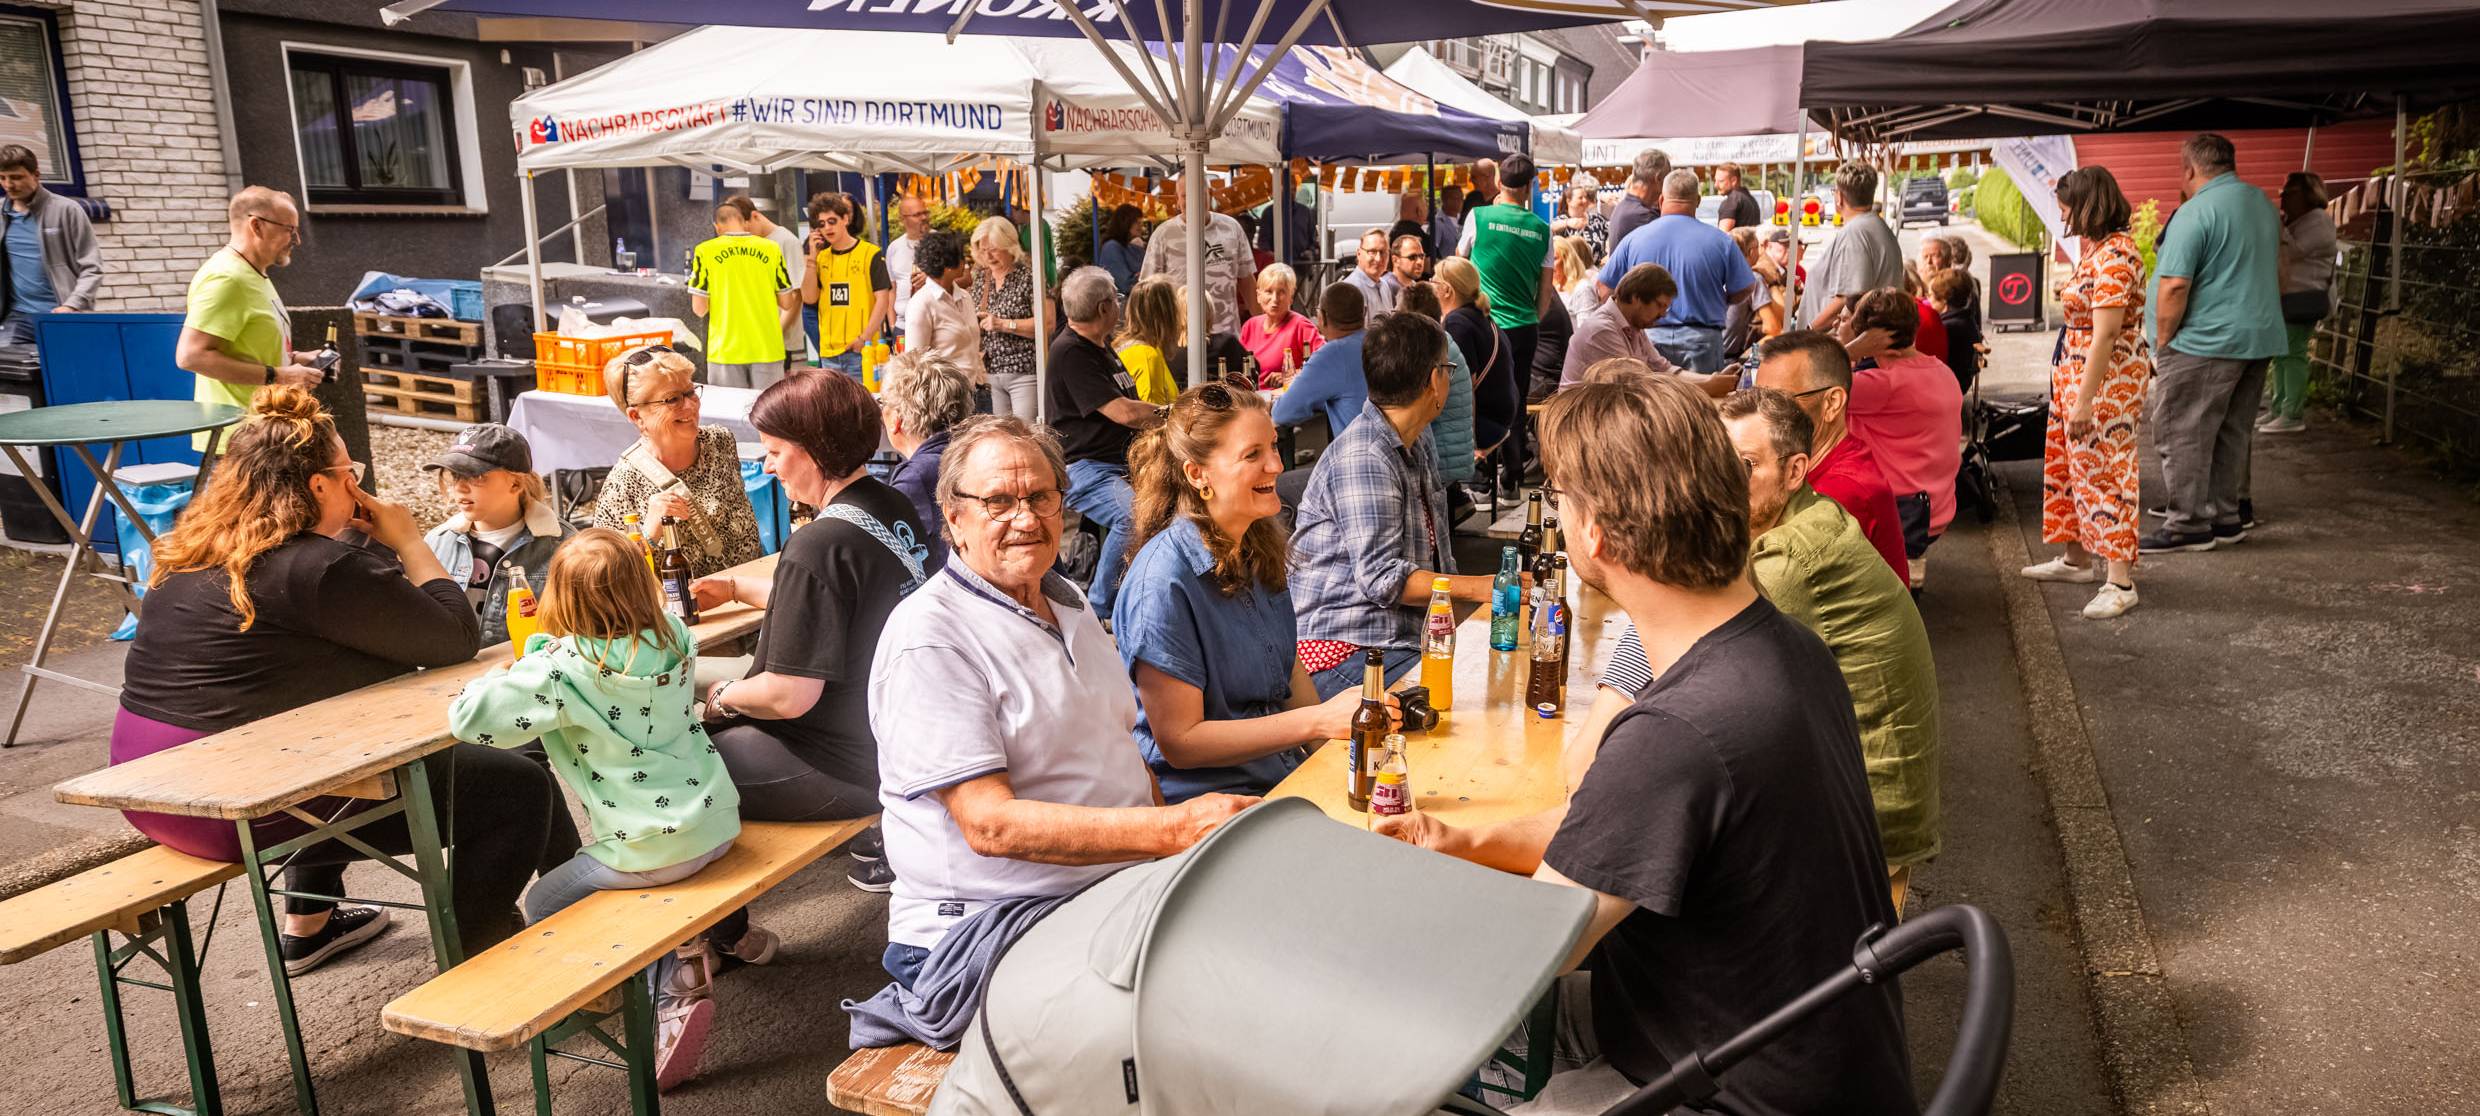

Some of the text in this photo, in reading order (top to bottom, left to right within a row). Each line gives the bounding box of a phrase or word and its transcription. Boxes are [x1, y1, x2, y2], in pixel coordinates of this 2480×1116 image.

[560, 97, 1002, 144] NACHBARSCHAFT #WIR SIND DORTMUND
[1066, 106, 1162, 133] NACHBARSCHA
[1584, 144, 1617, 161] UNT
[714, 246, 770, 265] DORTMUND
[831, 287, 849, 302] 1&1
